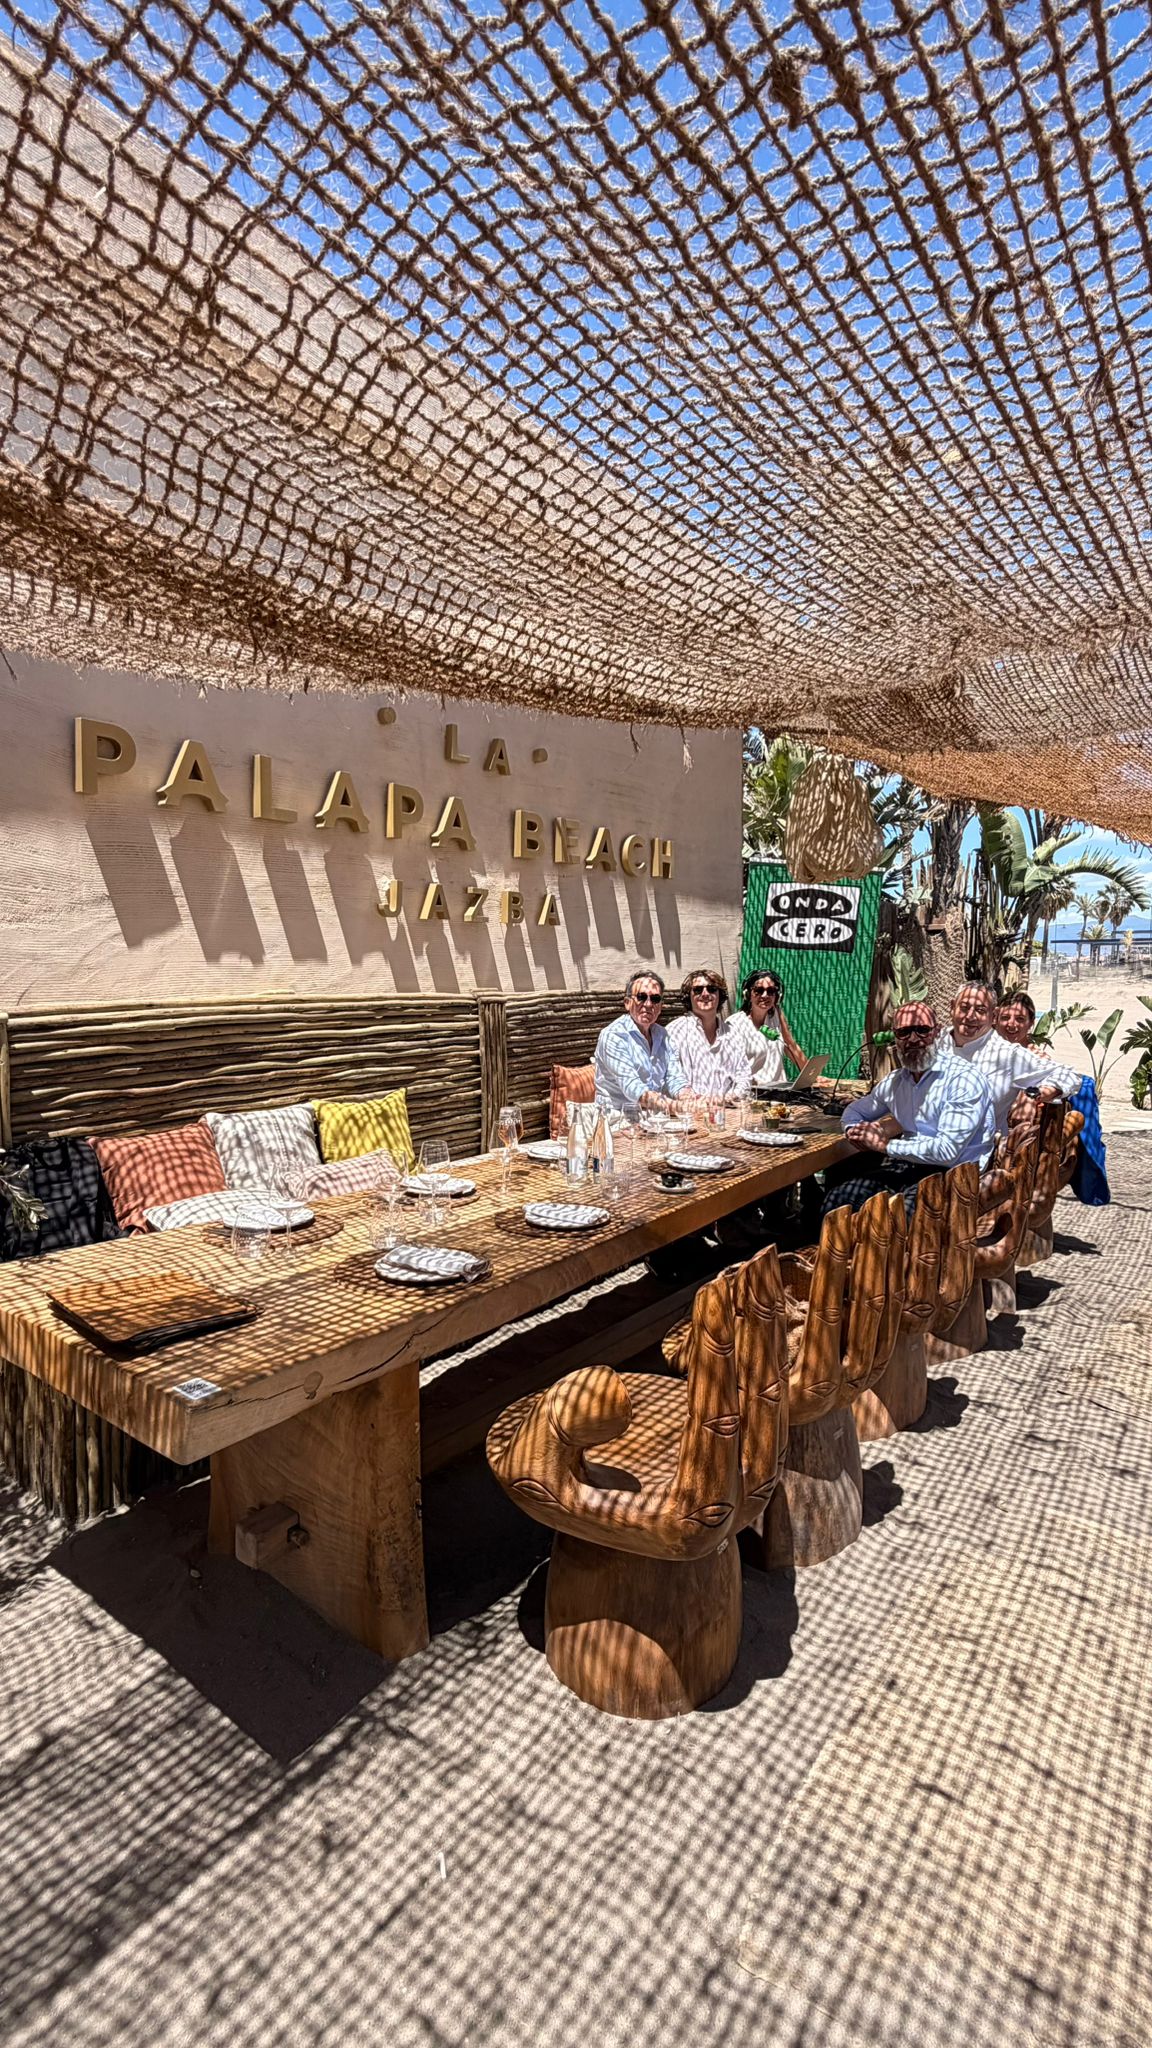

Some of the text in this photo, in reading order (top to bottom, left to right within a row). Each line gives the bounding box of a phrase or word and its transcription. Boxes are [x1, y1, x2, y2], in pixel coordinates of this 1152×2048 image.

[444, 723, 512, 776] LA
[73, 716, 674, 879] PALAPA BEACH
[377, 880, 561, 926] JAZBA
[779, 895, 845, 912] ONDA
[780, 922, 842, 940] CERO
